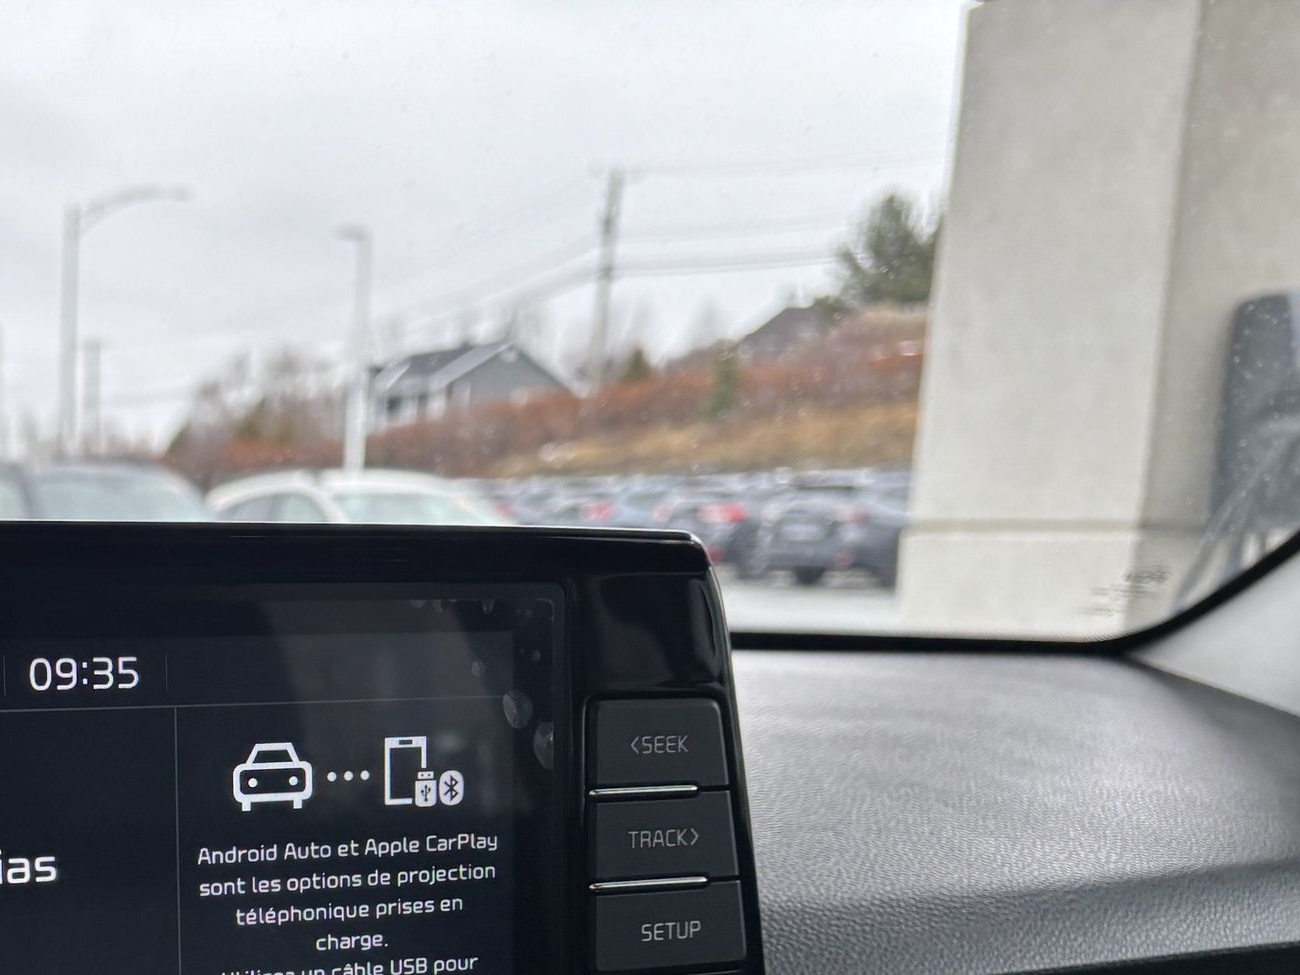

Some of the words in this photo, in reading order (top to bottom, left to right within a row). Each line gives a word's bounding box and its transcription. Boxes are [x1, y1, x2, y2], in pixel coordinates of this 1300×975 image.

[29, 656, 139, 691] 09:35
[197, 843, 278, 865] Android
[283, 841, 332, 861] Auto
[337, 839, 360, 857] et
[364, 836, 420, 858] Apple
[426, 833, 498, 852] CarPlay
[199, 877, 246, 897] sont
[252, 876, 282, 894] les
[286, 872, 362, 894] options
[367, 869, 391, 887] de
[397, 863, 496, 888] projection
[235, 902, 370, 926] téléphonique
[375, 898, 435, 920] prises
[439, 898, 463, 912] en
[315, 933, 389, 951] charge.
[641, 920, 701, 942] SETUP
[390, 957, 428, 975] USB
[433, 956, 479, 975] pour
